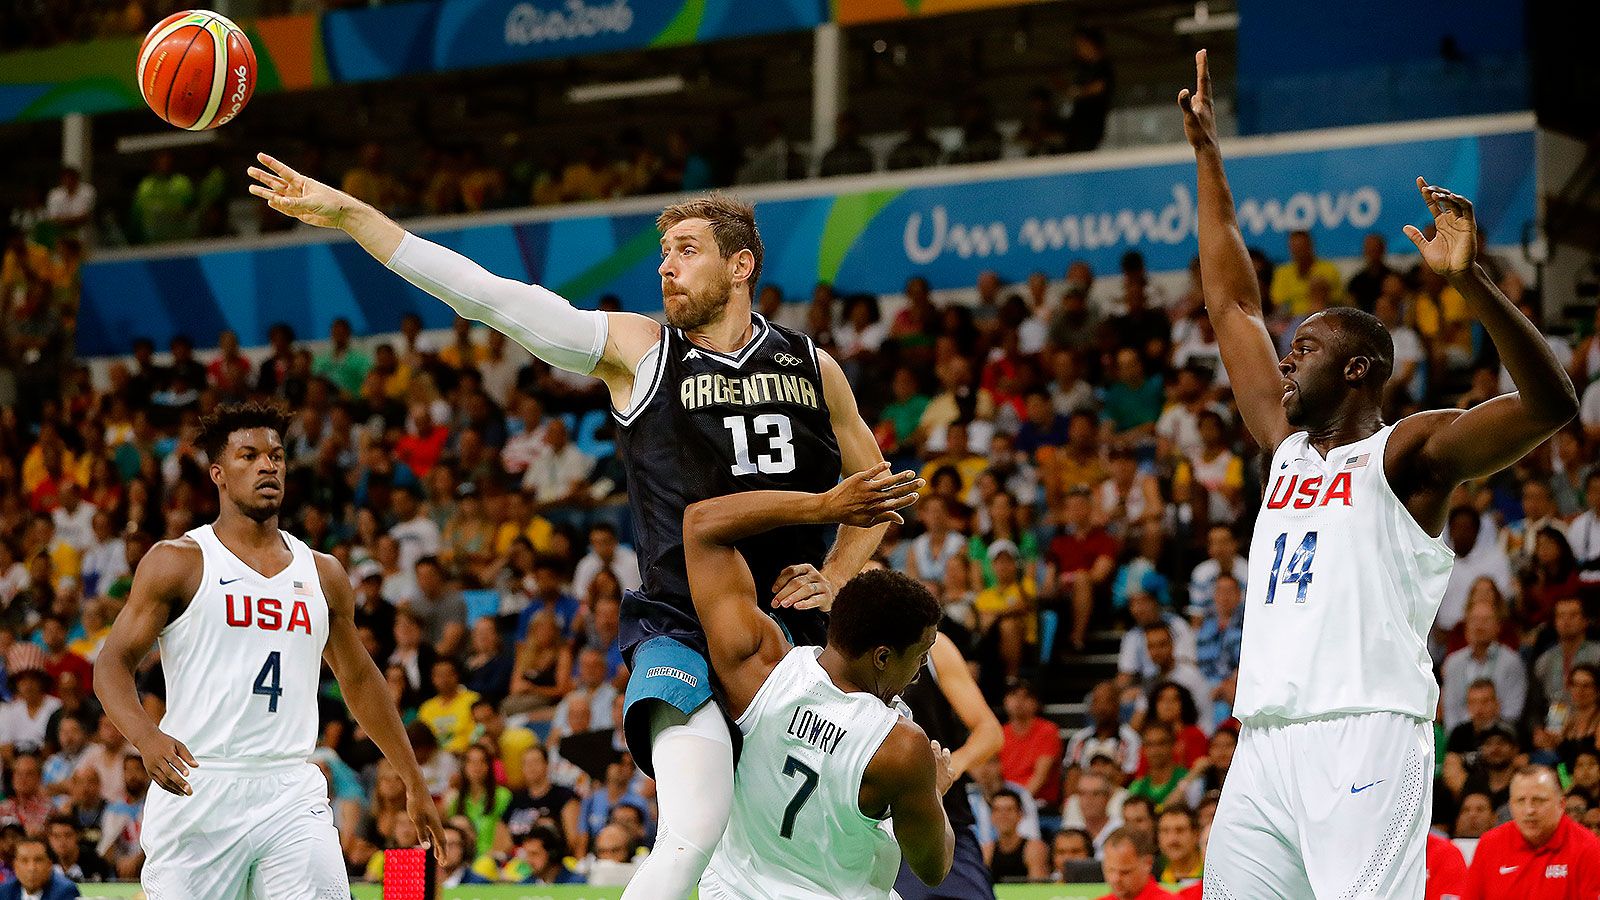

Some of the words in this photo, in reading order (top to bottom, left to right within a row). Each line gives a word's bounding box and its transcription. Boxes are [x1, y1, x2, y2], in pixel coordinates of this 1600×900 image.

[903, 205, 1009, 264] Um
[1018, 183, 1198, 252] mund
[1238, 186, 1381, 235] novo
[680, 372, 819, 410] ARGENTINA
[723, 413, 796, 476] 13
[1266, 471, 1353, 510] USA
[1265, 531, 1318, 604] 14
[225, 594, 312, 636] USA
[252, 651, 283, 713] 4
[646, 666, 698, 688] ARGENTINA
[786, 705, 848, 756] LOWRY
[779, 754, 820, 840] 7
